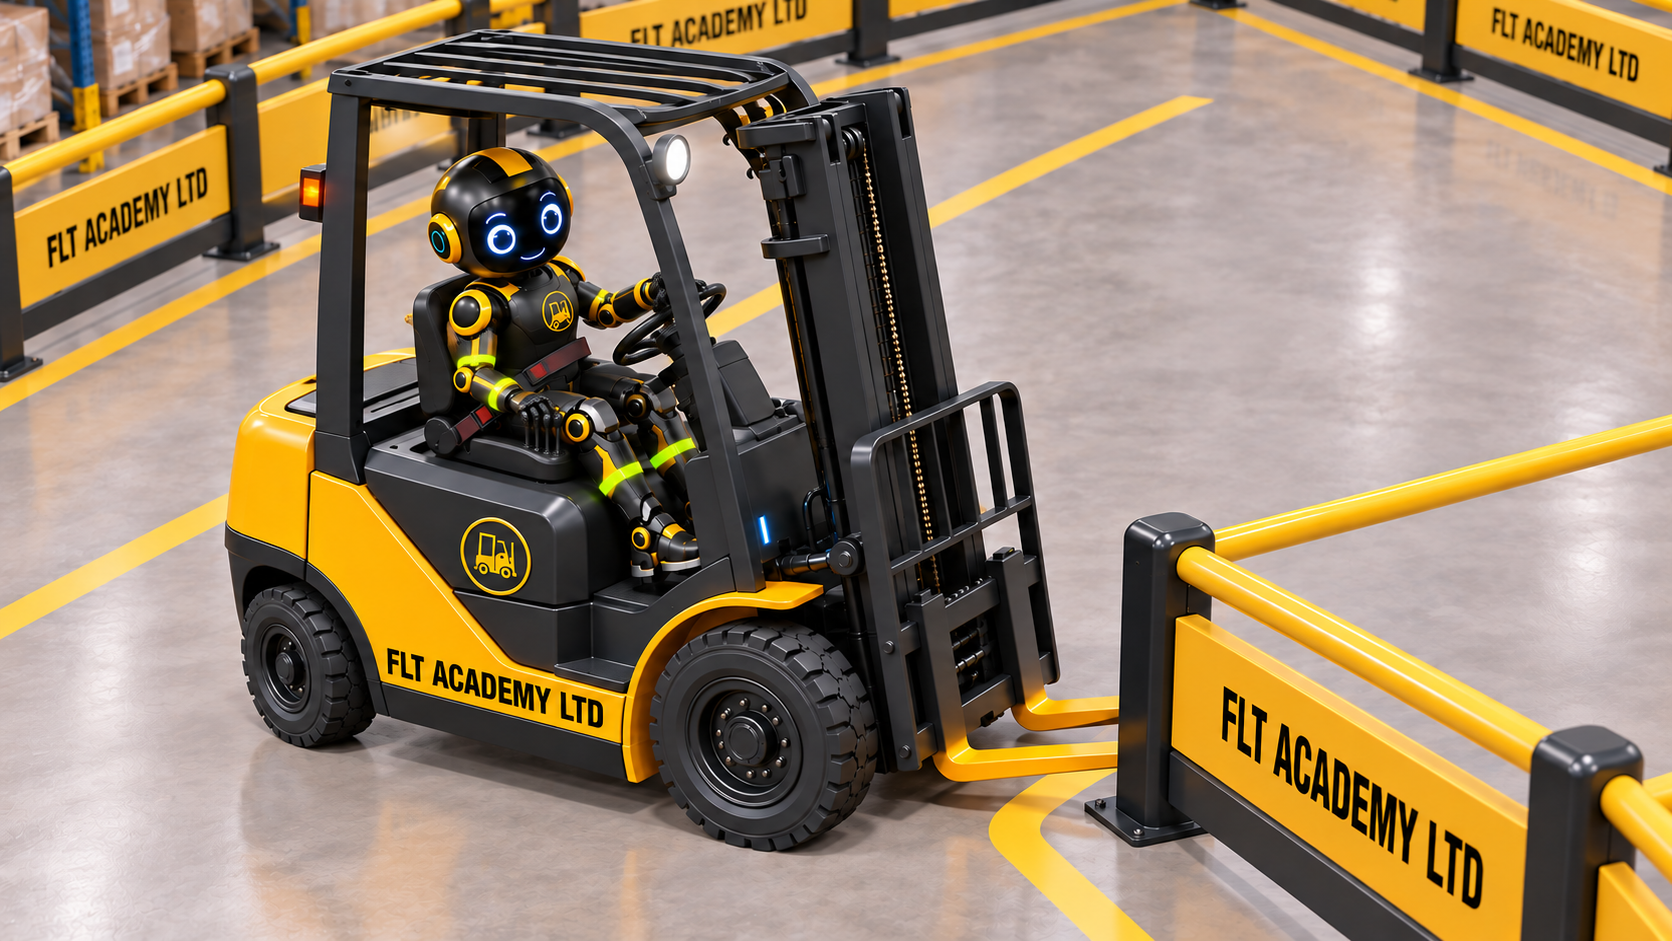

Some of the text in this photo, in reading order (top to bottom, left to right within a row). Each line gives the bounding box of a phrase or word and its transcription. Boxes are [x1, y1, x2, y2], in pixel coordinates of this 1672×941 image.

[631, 0, 807, 47] FLT ACADEMY LTD
[1492, 7, 1639, 82] FLT ACADEMY LTD
[46, 167, 208, 268] FLT ACADEMY LTD
[386, 647, 604, 729] FLT ACADEMY LTD
[1221, 685, 1484, 910] FLT ACADEMY LTD
